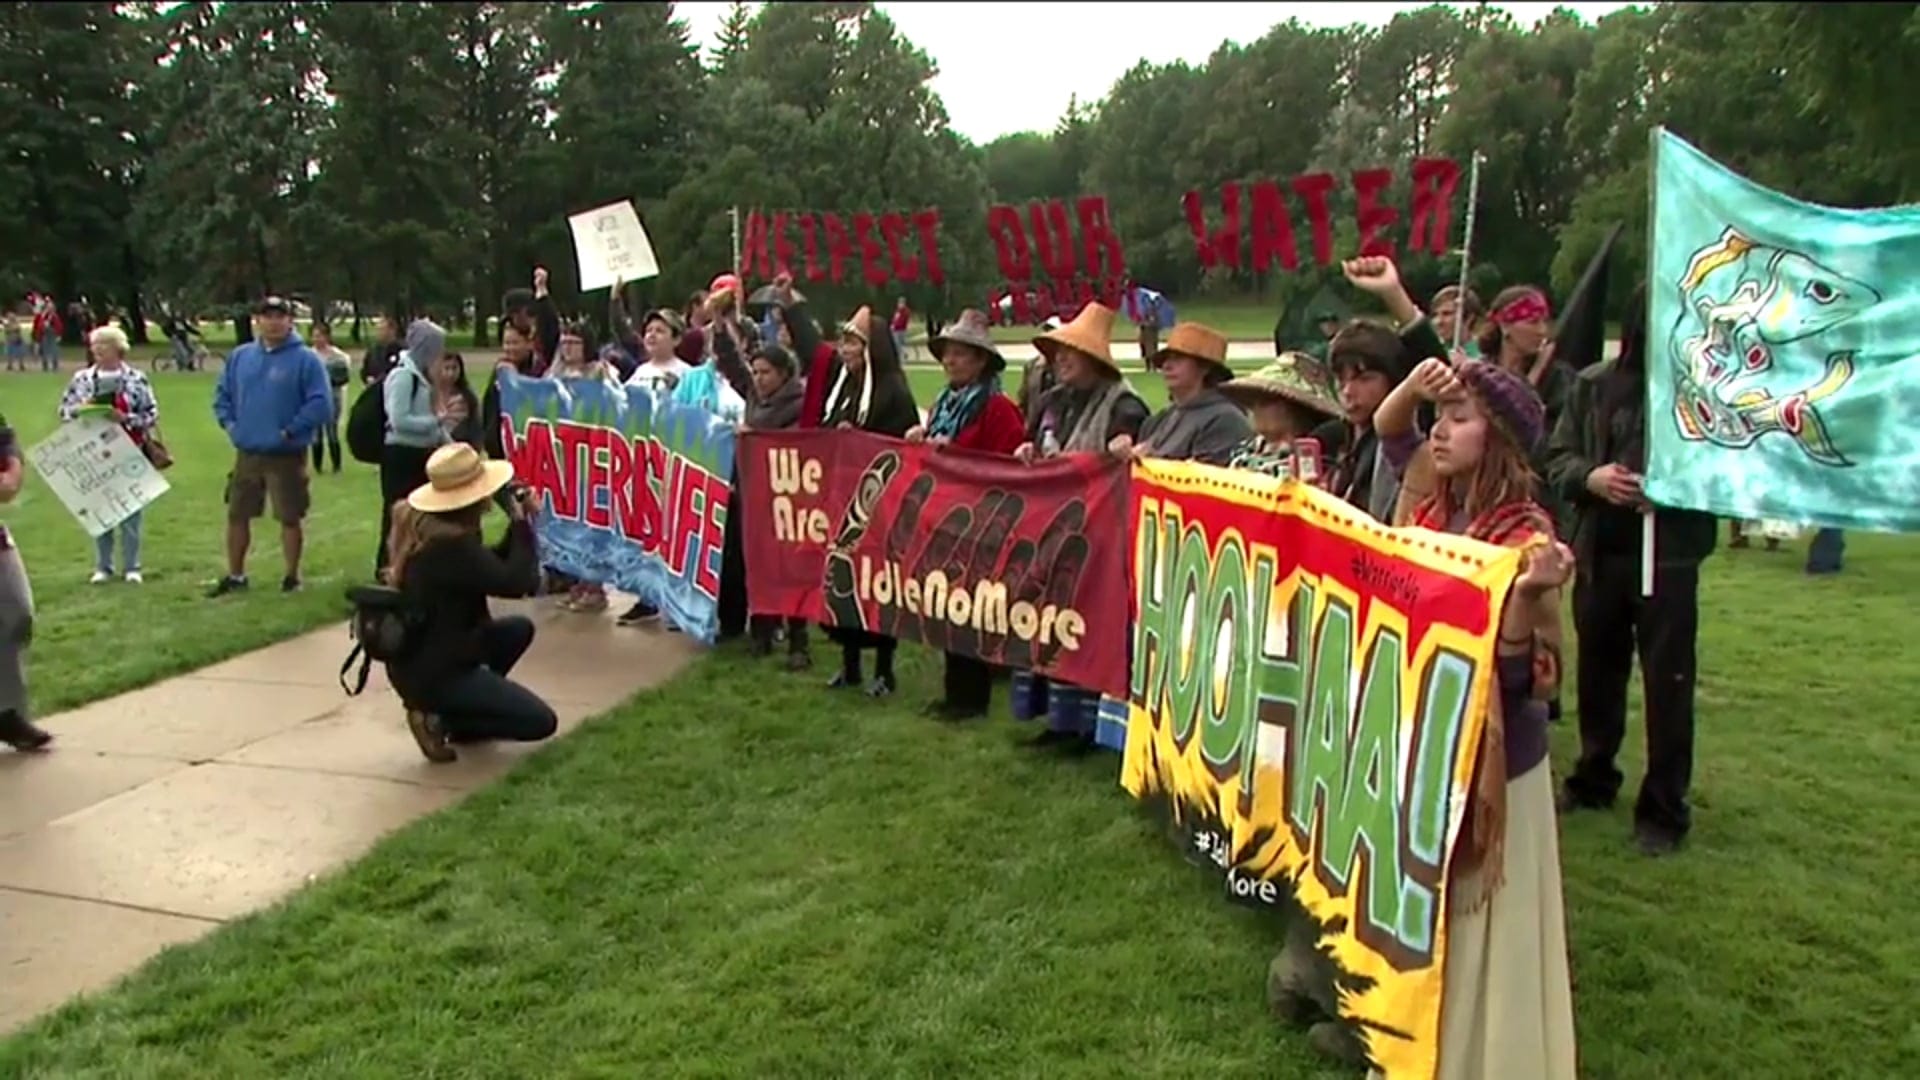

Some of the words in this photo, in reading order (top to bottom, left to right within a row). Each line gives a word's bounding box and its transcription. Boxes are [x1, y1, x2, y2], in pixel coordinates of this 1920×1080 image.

[986, 195, 1127, 282] OUR
[1181, 158, 1463, 273] WATER
[500, 412, 645, 546] WATER
[661, 451, 731, 601] IFE
[768, 447, 824, 495] We
[772, 496, 830, 545] Are
[860, 555, 1087, 652] IdleNoMore
